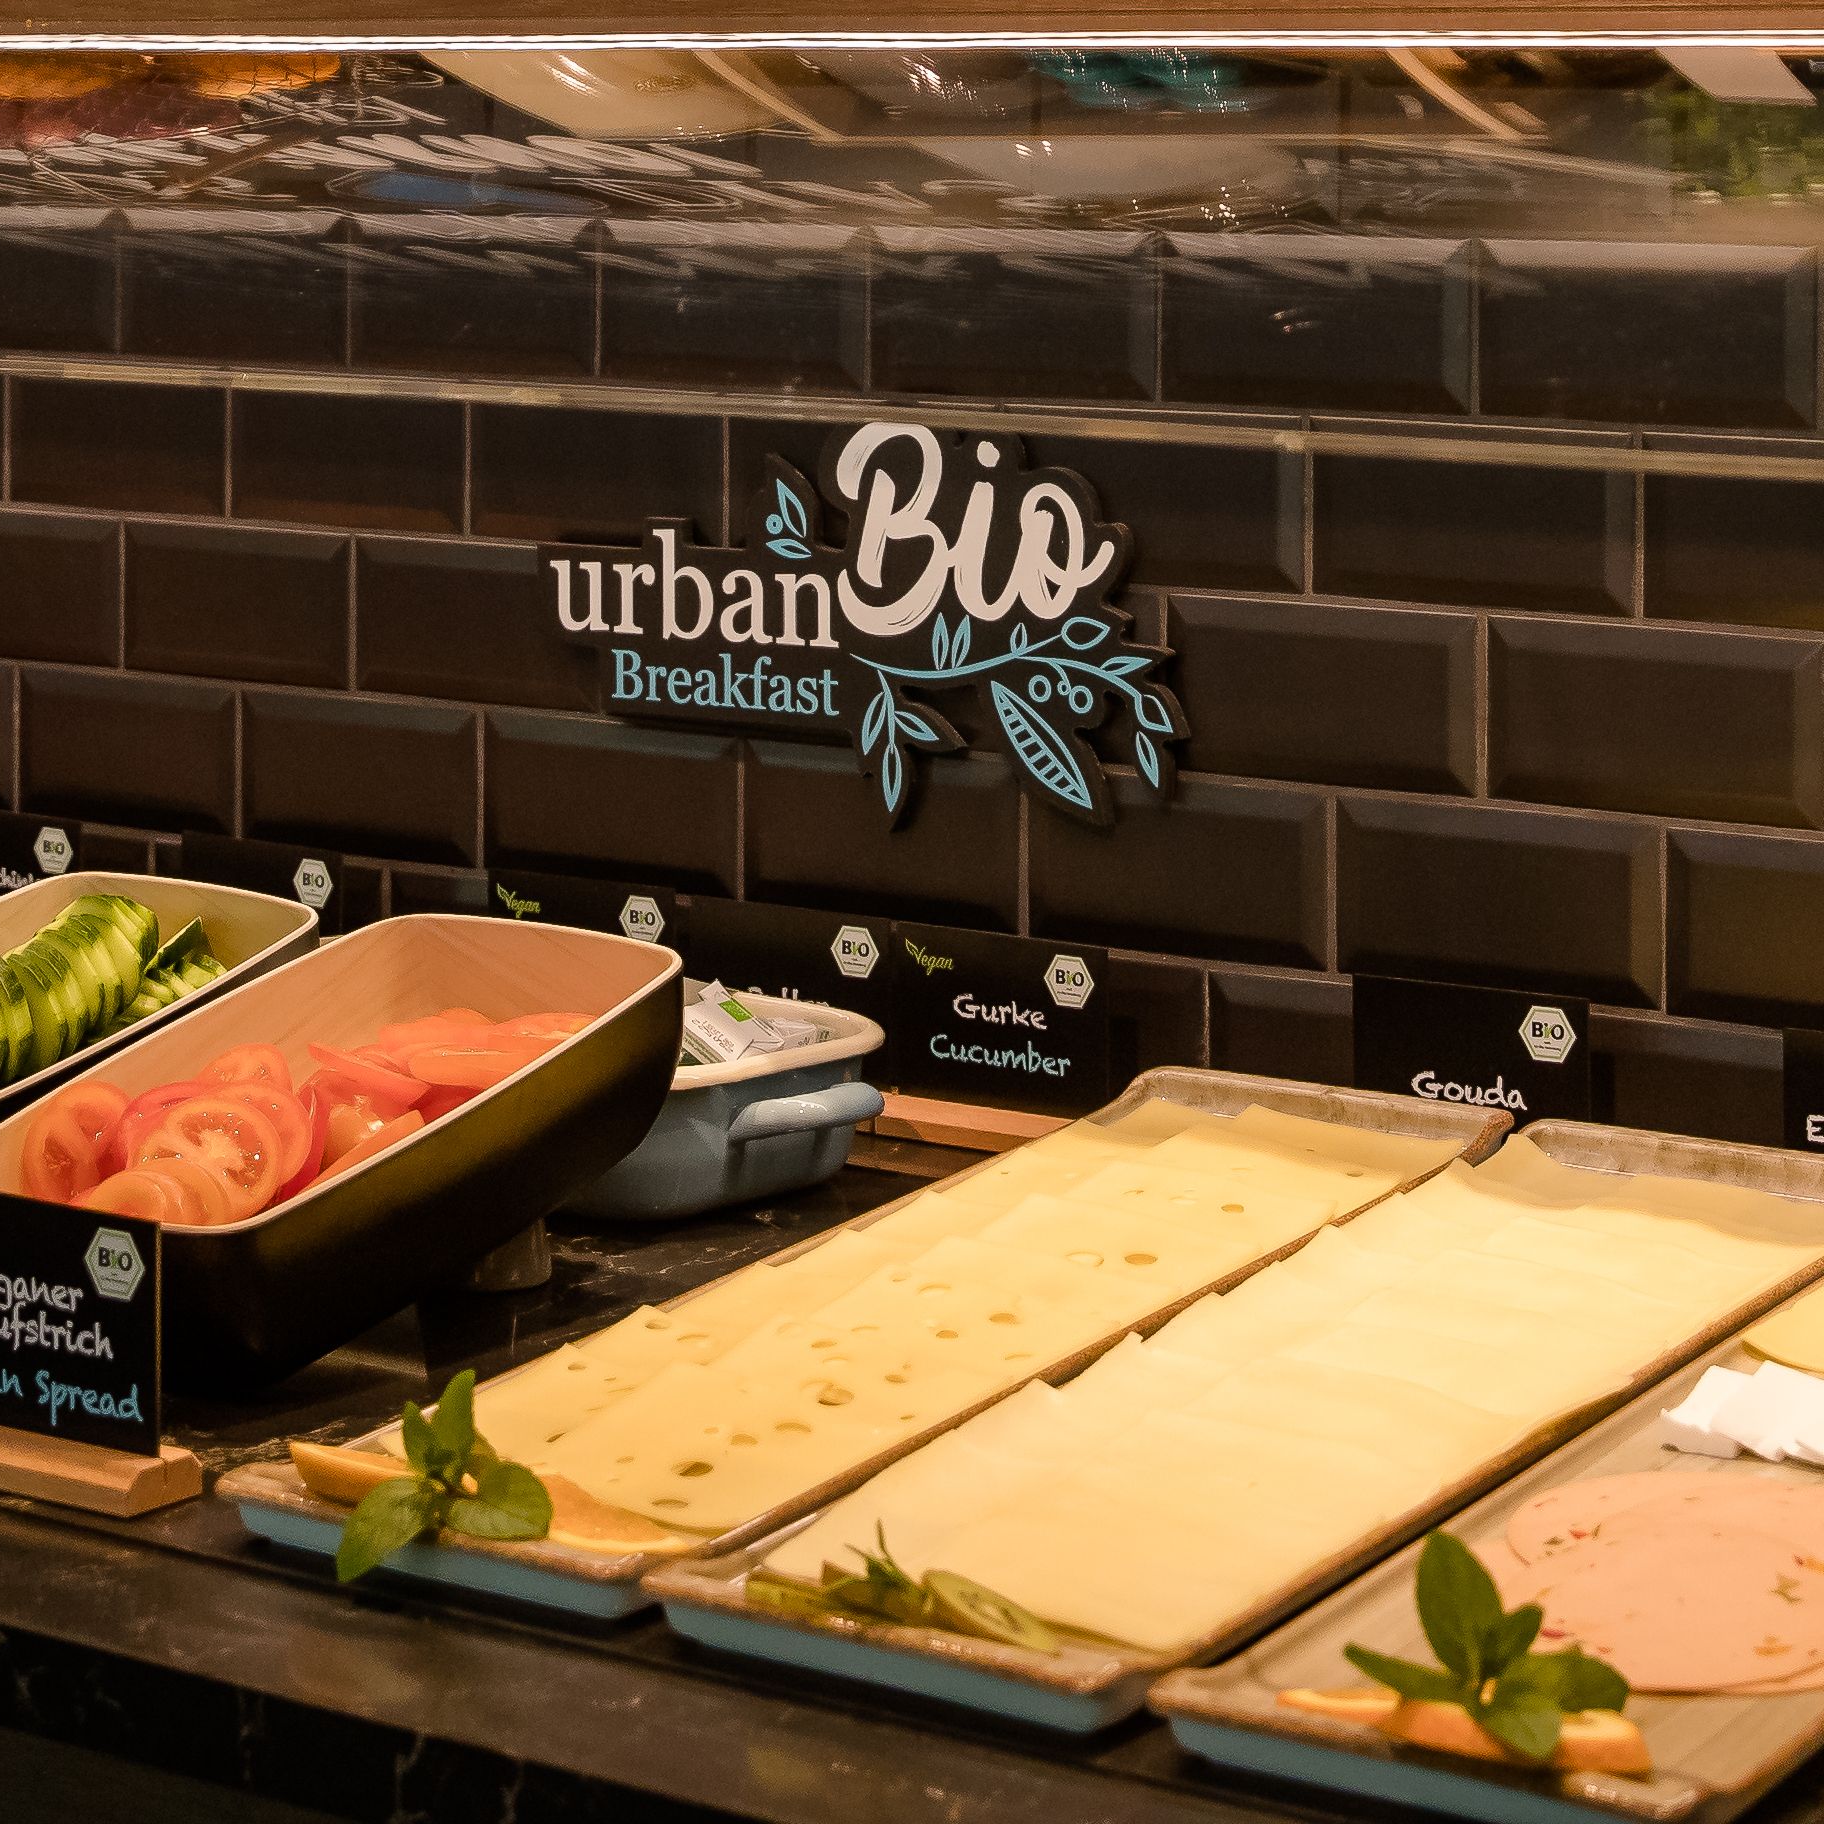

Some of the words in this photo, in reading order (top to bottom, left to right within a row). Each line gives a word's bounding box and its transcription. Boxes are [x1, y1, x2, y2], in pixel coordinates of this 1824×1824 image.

[610, 648, 840, 717] Breakfast
[905, 939, 954, 976] Vegan
[953, 993, 1048, 1030] Gurke
[930, 1034, 1071, 1077] Cucumber
[1411, 1071, 1527, 1111] Gouda
[34, 1369, 145, 1427] Spread
